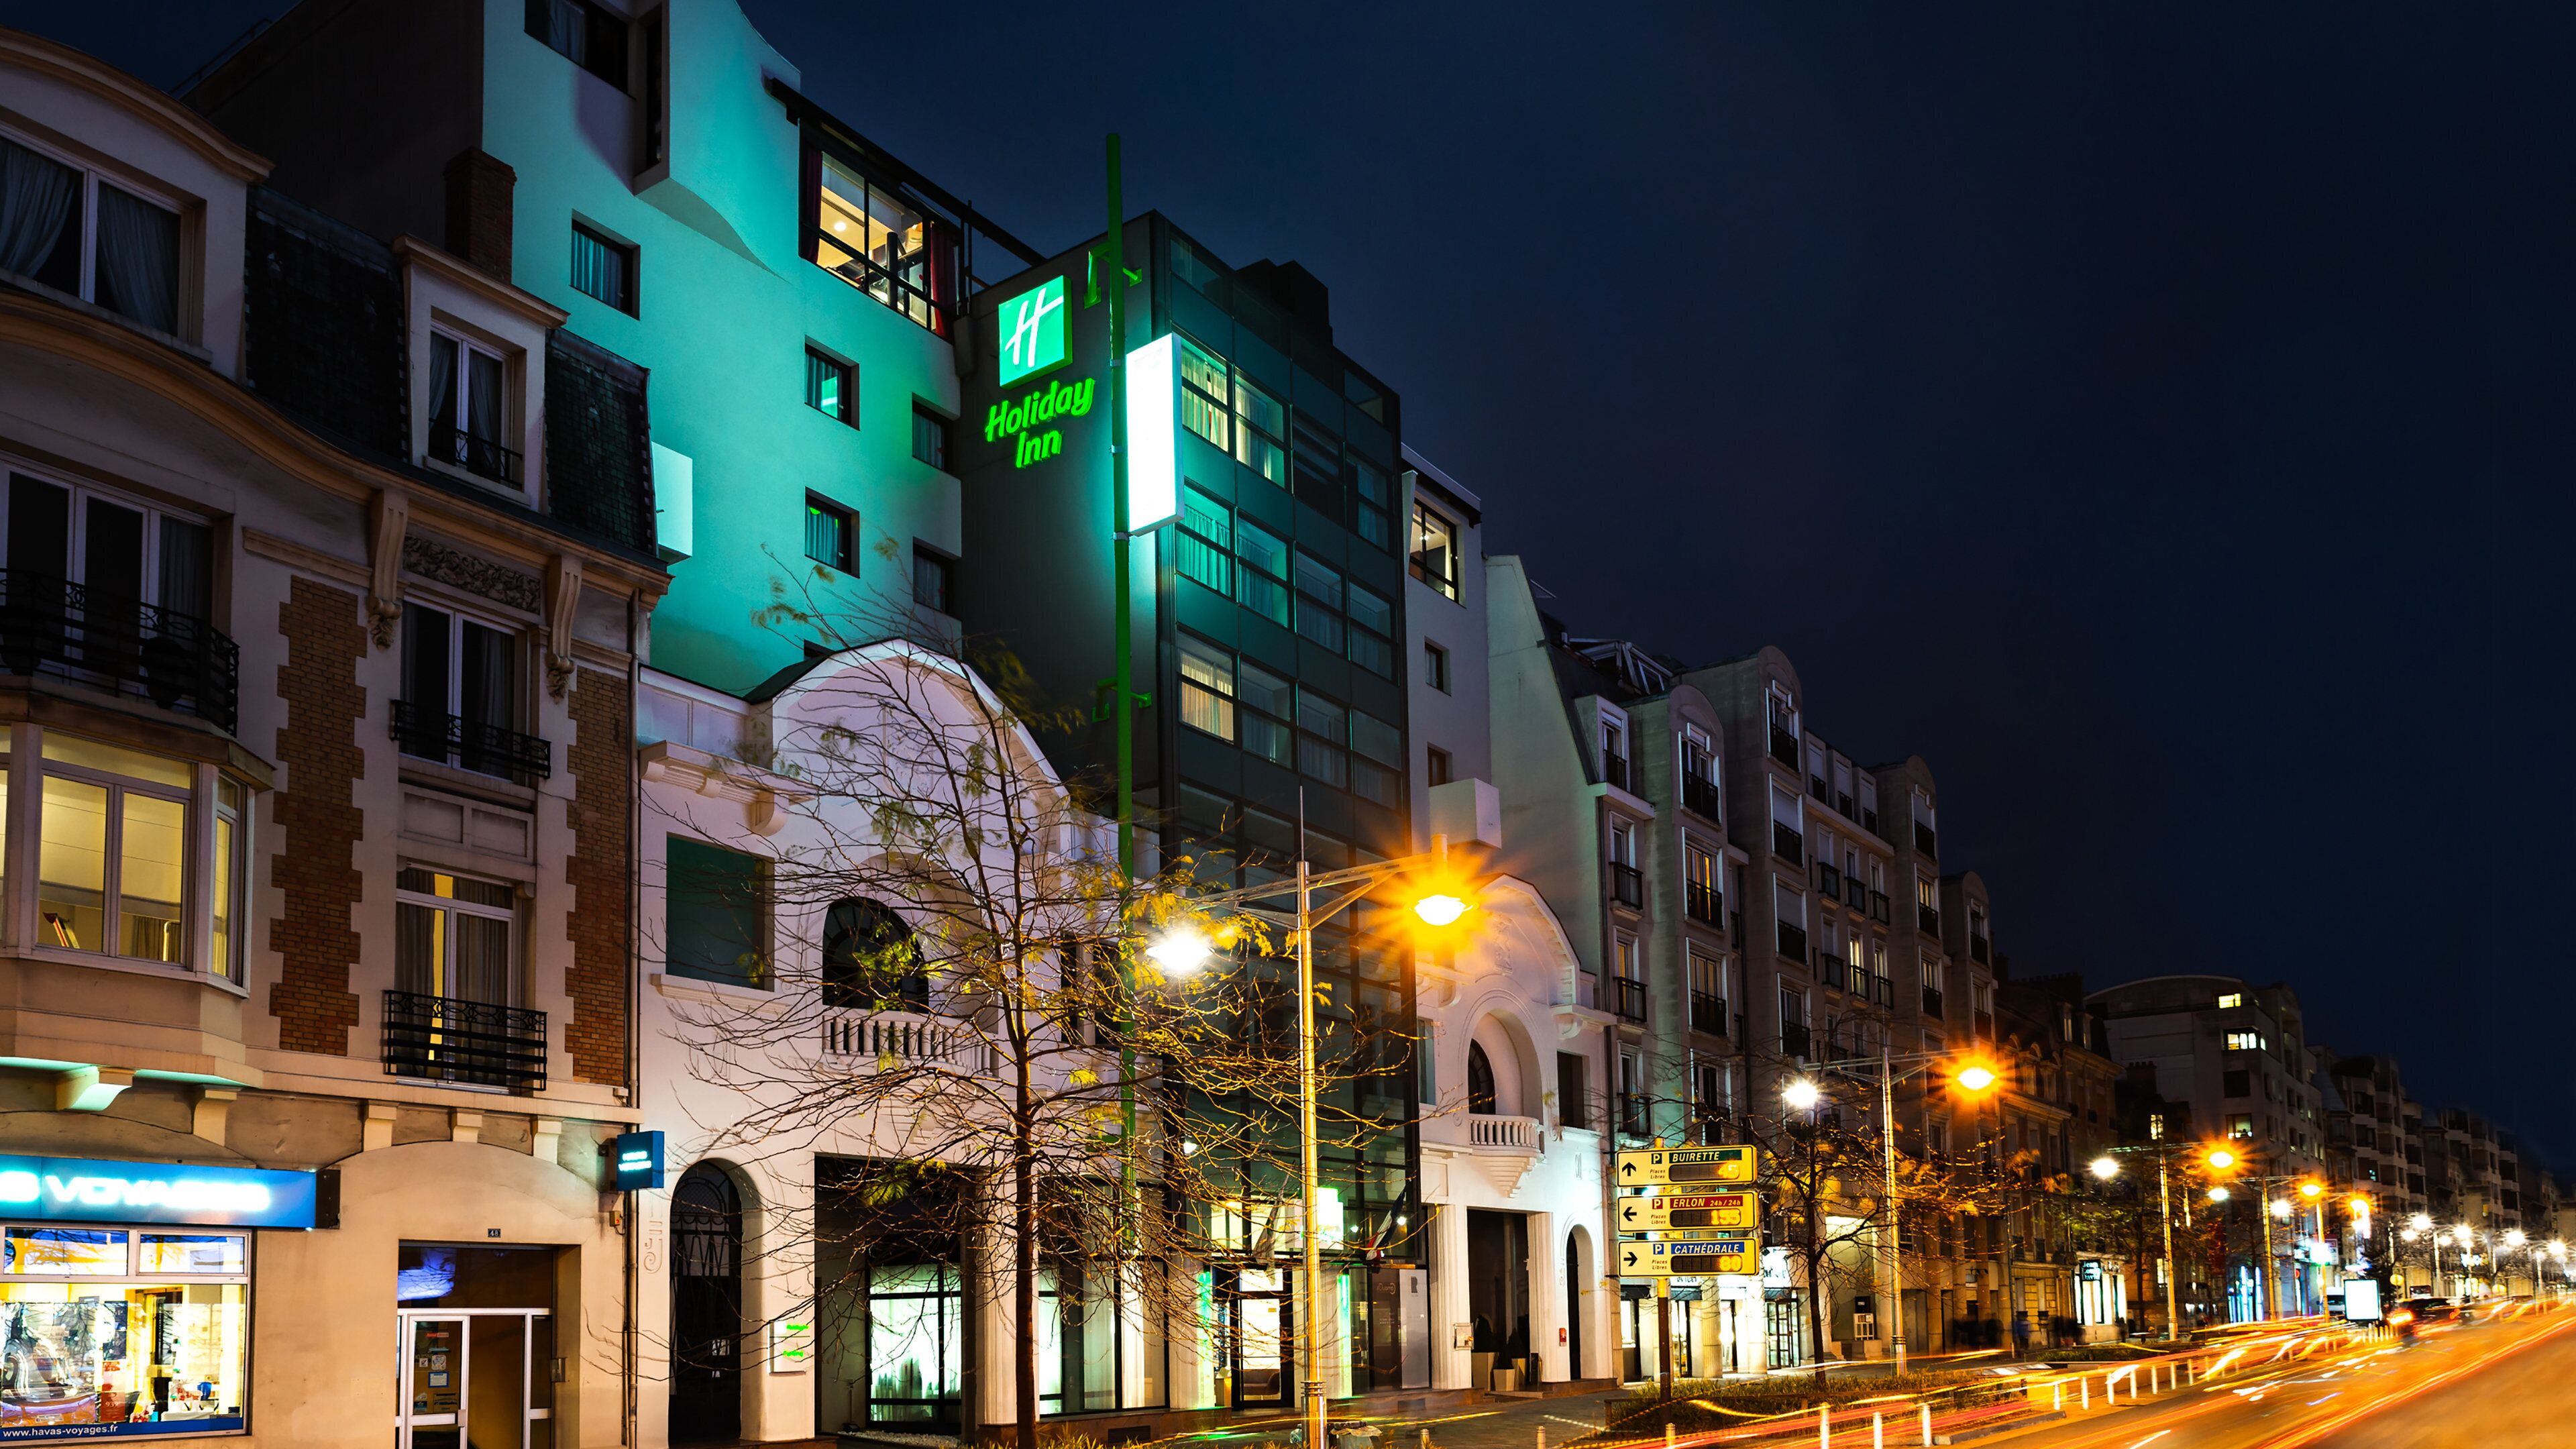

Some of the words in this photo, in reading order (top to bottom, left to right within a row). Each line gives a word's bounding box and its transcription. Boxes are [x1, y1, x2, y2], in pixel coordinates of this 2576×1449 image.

[1004, 287, 1064, 368] H
[985, 378, 1095, 443] Holiday
[1016, 430, 1063, 468] Inn
[1653, 1154, 1660, 1164] P
[1672, 1151, 1720, 1162] BUIRETTE
[45, 1175, 269, 1211] VOYA
[1654, 1199, 1661, 1209] P
[1673, 1198, 1705, 1208] ERLON
[1655, 1244, 1662, 1254] P
[1674, 1242, 1739, 1254] CATHÉDRALE
[1720, 1256, 1741, 1271] 80
[3, 1424, 118, 1438] www.havas-voyages.fr
